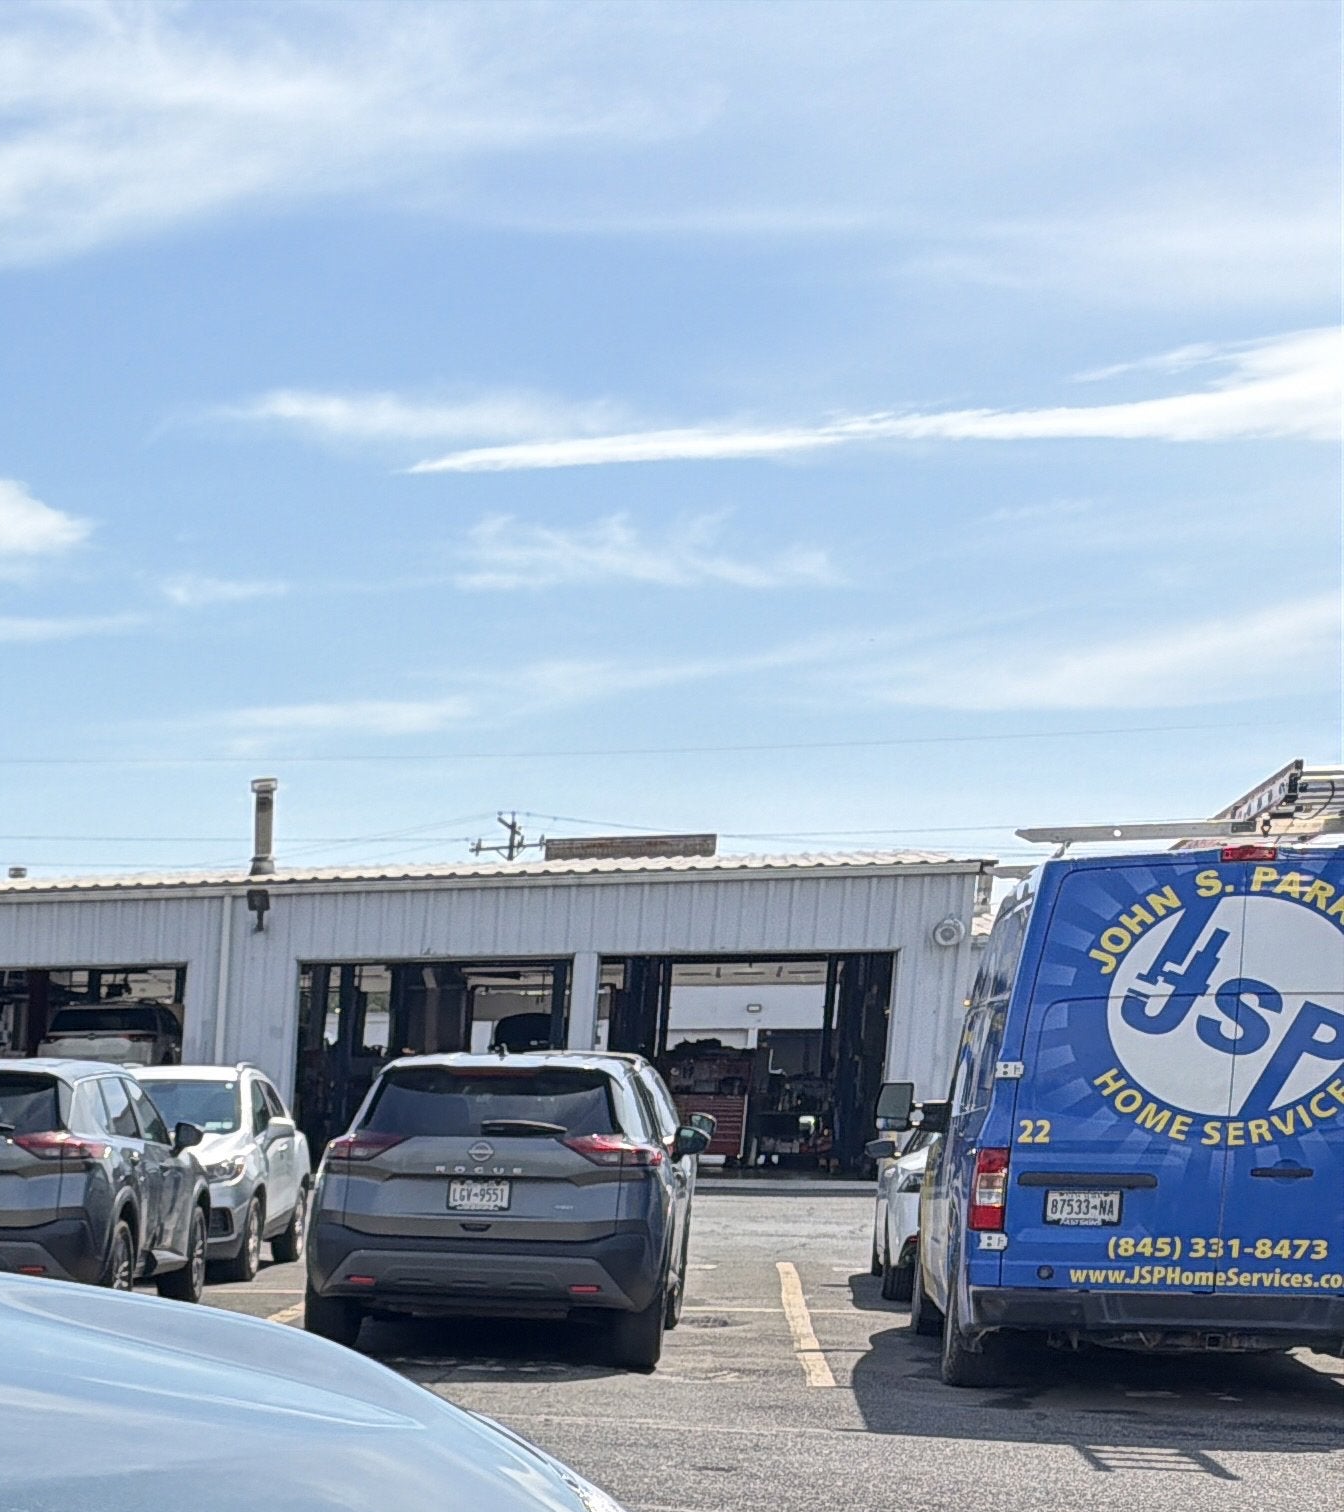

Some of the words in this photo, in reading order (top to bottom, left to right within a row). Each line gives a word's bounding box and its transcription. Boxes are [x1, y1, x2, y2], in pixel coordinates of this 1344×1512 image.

[1089, 885, 1181, 974] JOHN
[1195, 869, 1234, 897] S.
[1093, 1067, 1194, 1141] HOME
[1201, 1078, 1344, 1146] SERVICE
[1017, 1119, 1051, 1143] 22
[1108, 1236, 1182, 1260] (845)
[1189, 1237, 1328, 1260] 331-8473
[1069, 1265, 1344, 1289] www.JSPHomeServices.co
